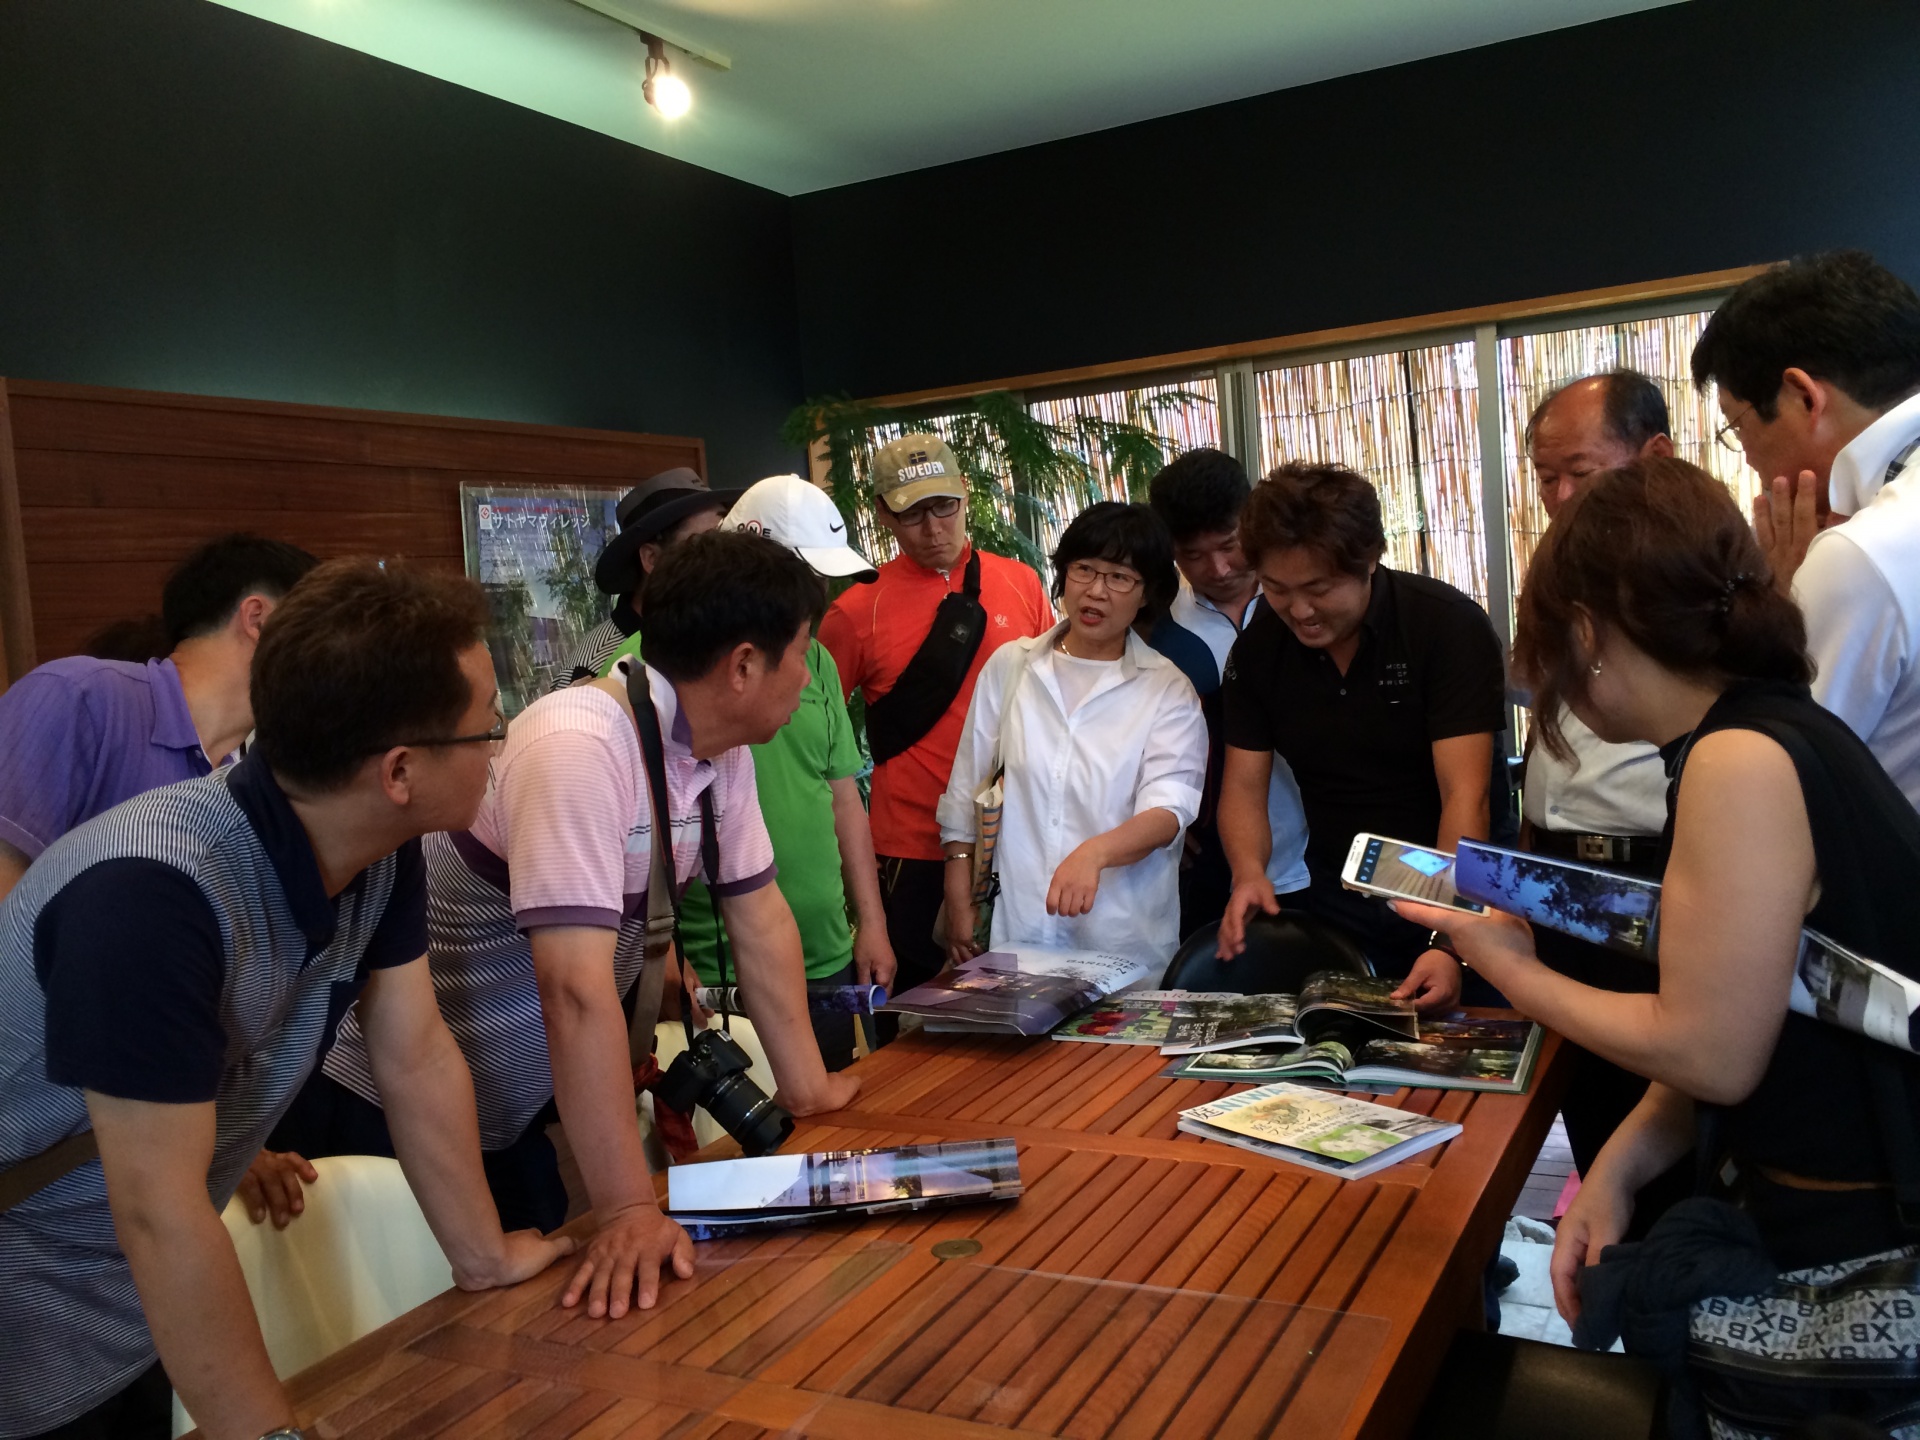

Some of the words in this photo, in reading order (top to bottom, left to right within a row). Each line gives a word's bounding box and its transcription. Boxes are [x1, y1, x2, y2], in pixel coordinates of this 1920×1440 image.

[897, 461, 945, 483] SWEDEN
[492, 512, 590, 529] サトヤマヴィレッジ
[737, 521, 772, 538] ONE
[1211, 1086, 1286, 1113] NIWA
